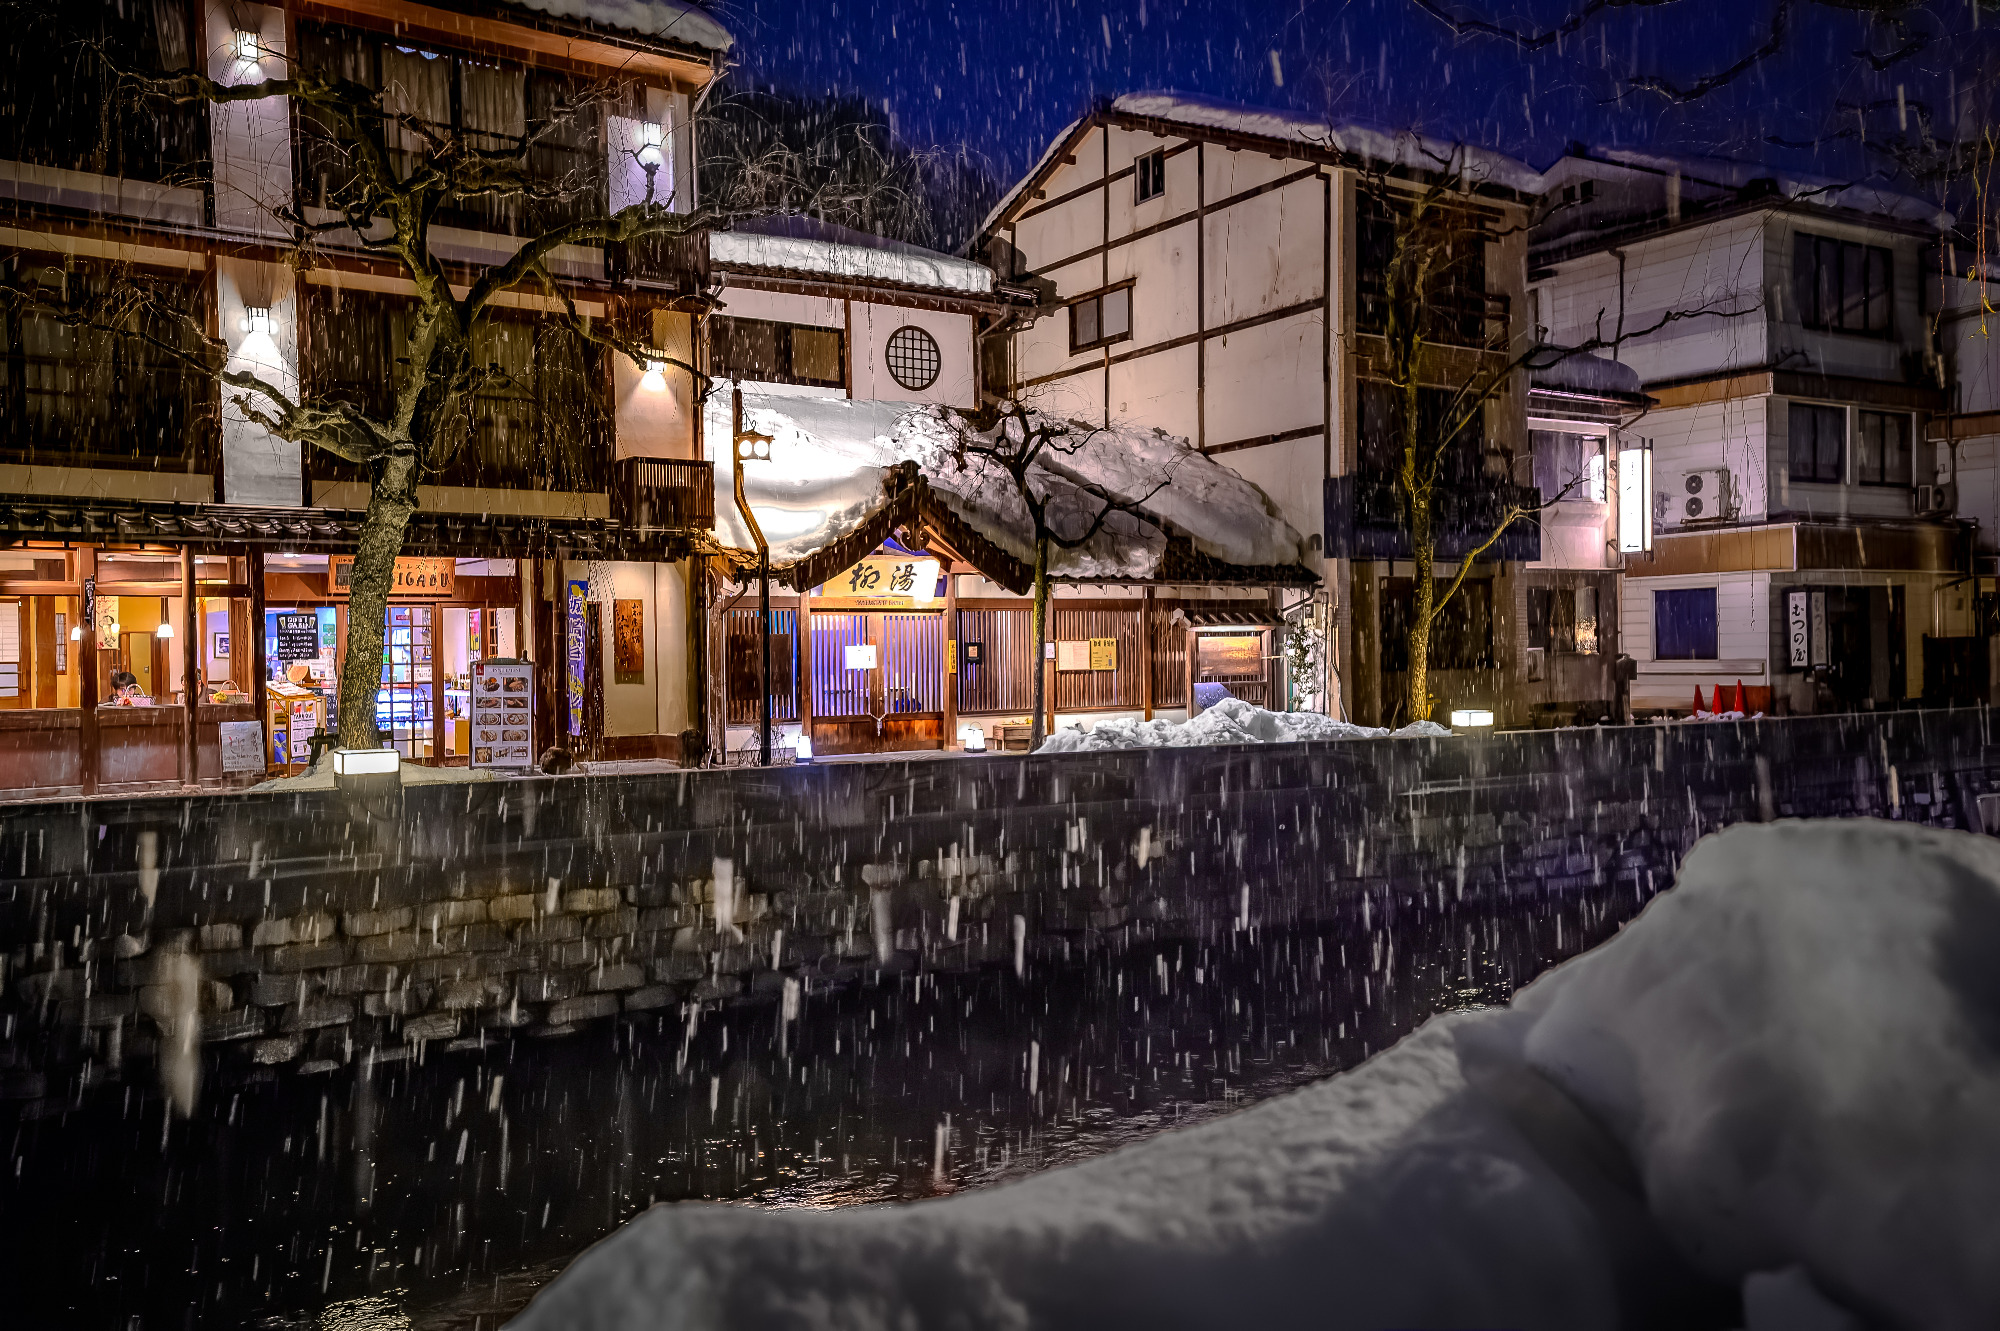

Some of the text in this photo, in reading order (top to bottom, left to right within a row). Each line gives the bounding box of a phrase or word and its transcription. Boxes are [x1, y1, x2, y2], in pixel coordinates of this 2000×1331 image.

[849, 563, 917, 592] 柳湯
[1792, 604, 1806, 662] むつの屋
